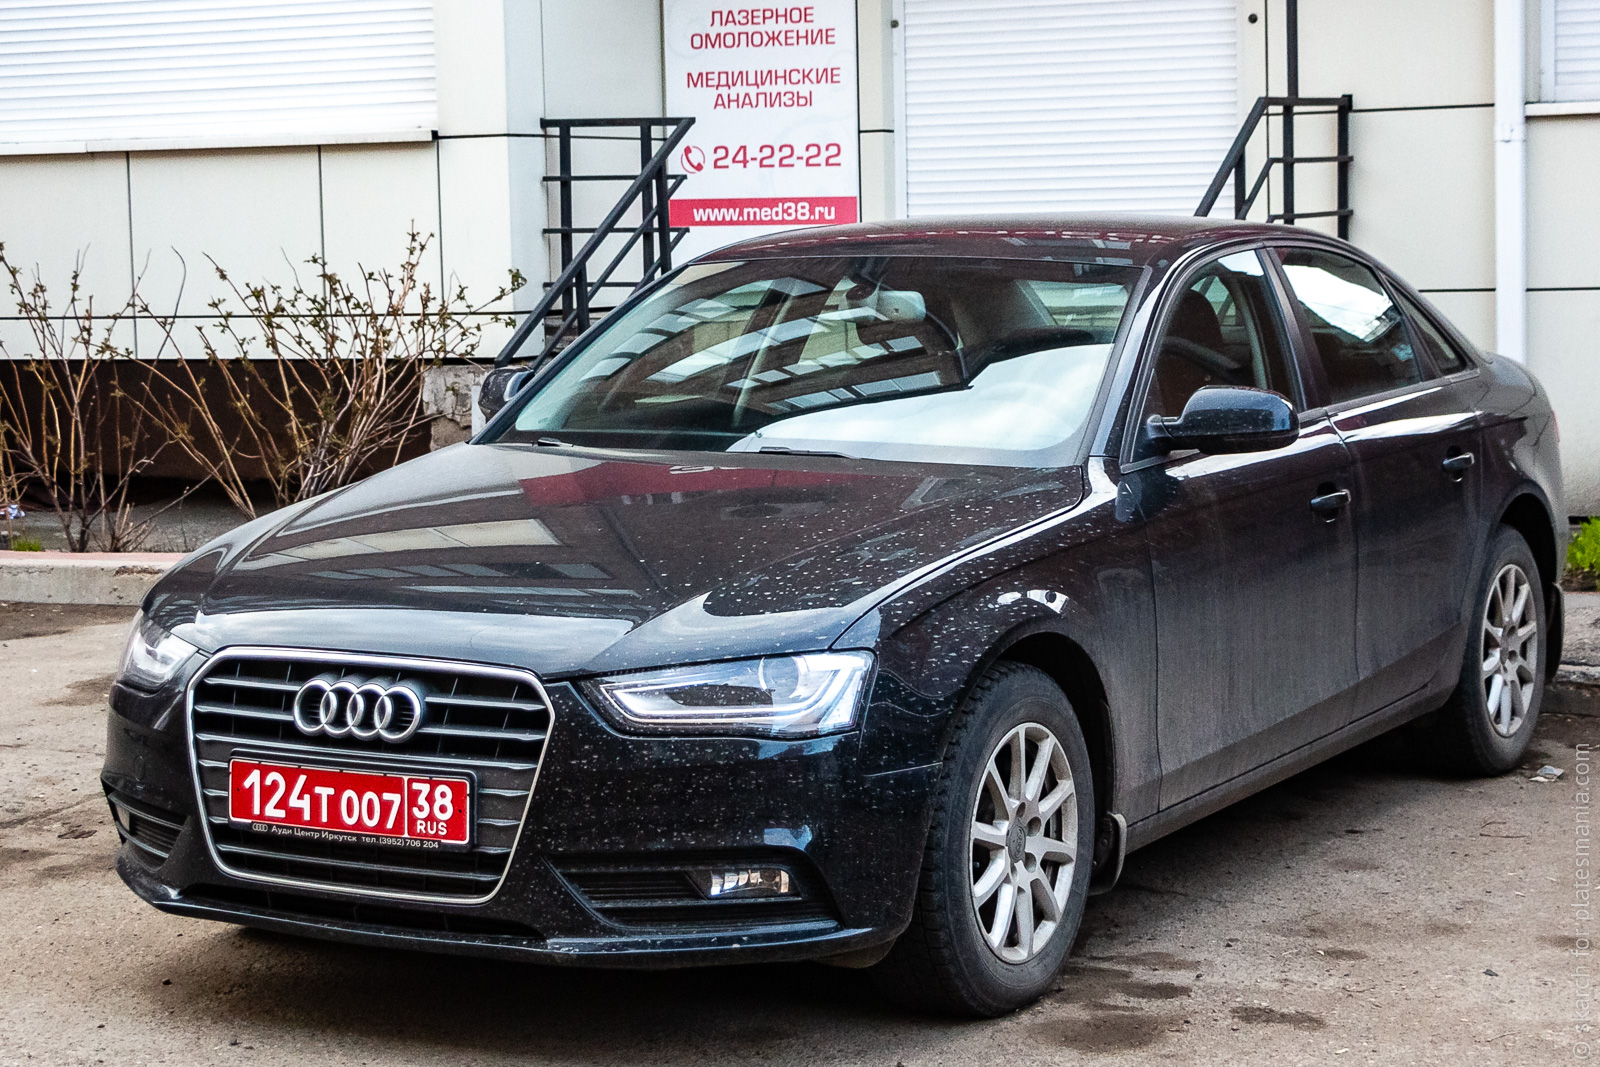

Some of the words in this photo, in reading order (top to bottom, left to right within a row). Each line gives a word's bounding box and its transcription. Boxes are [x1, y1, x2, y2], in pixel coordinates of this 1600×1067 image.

[710, 6, 815, 27] ЛАЗЕРНОЕ
[690, 28, 836, 50] ОМОЛОЖЕНИЕ
[686, 67, 841, 90] МЕДИЦИНСКИЕ
[713, 91, 813, 110] АНАЛИЗЫ
[713, 142, 842, 170] 24-22-22
[692, 202, 836, 222] www.med38.ru
[411, 783, 454, 821] 38
[271, 826, 293, 836] Ауди
[294, 827, 320, 840] Центр
[321, 831, 358, 844] Иркутск
[423, 840, 439, 850] 204
[416, 820, 448, 836] RUS
